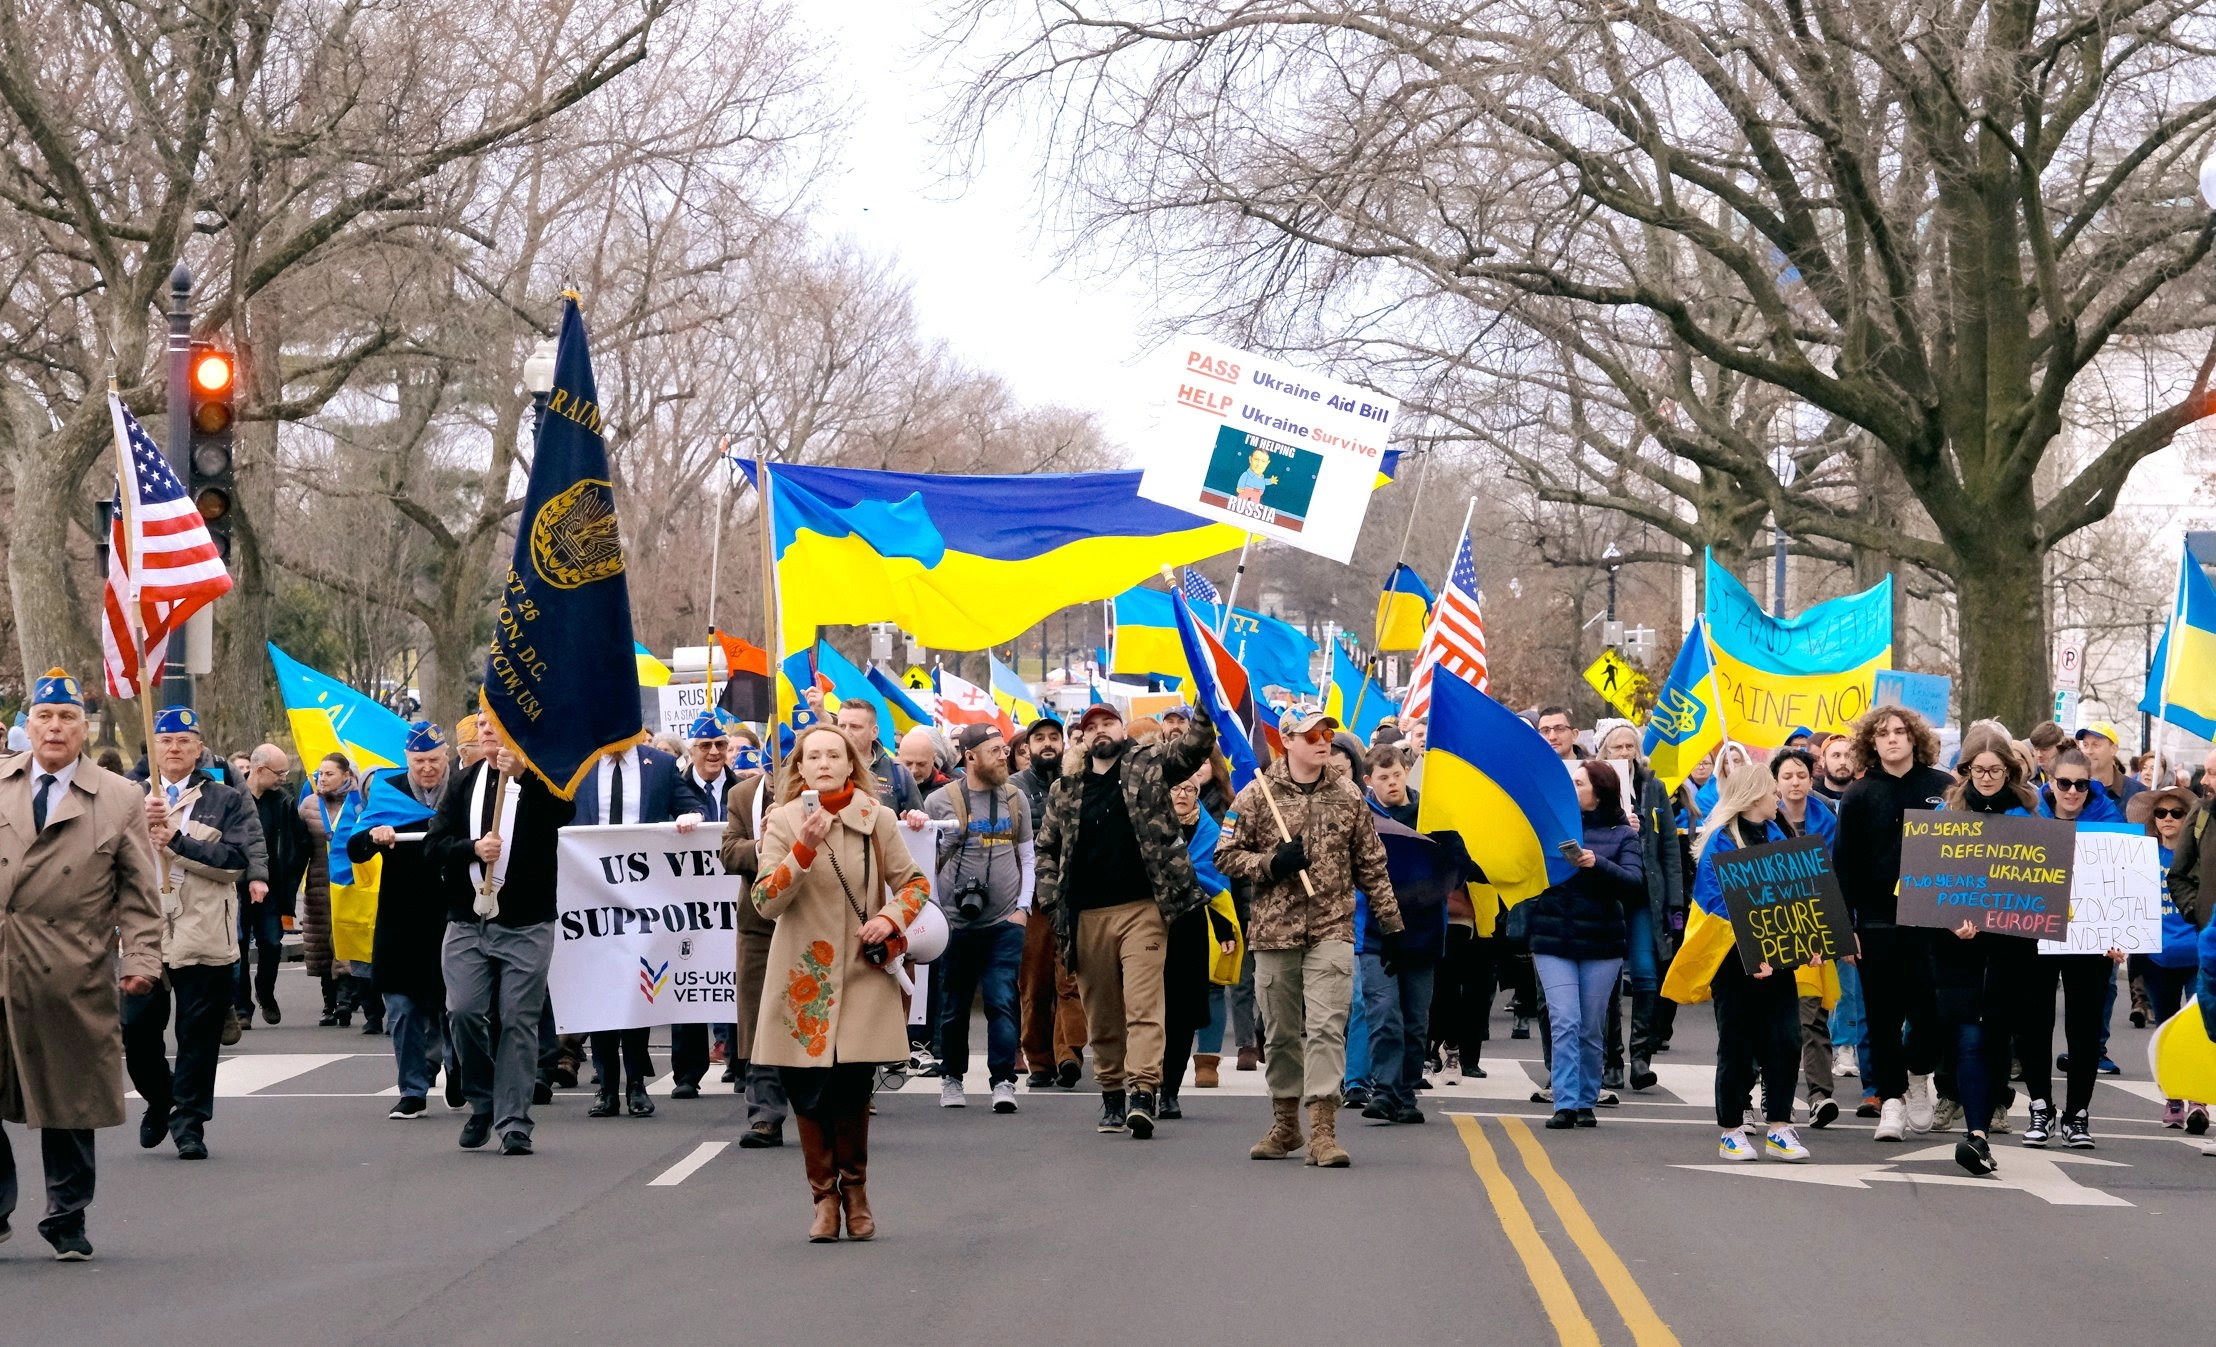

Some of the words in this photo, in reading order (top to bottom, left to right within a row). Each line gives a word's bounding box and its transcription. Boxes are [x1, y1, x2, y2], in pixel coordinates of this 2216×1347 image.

[1187, 351, 1241, 381] PASS
[1252, 370, 1321, 402] Ukraine
[1327, 395, 1356, 413] Aid
[1359, 403, 1389, 423] Bill
[1177, 384, 1233, 411] HELP
[1241, 404, 1309, 437] Ukraine
[1311, 428, 1377, 458] Survive
[1244, 433, 1258, 448] I'M
[1259, 437, 1296, 459] HELPING
[1226, 495, 1277, 524] RUSSIA
[507, 566, 526, 595] ST
[517, 599, 540, 621] 26
[1710, 577, 1792, 656] STAND
[1805, 600, 1880, 656] WITH
[517, 645, 547, 682] D.C.
[516, 689, 543, 722] USA
[665, 710, 671, 721] IS
[674, 710, 681, 720] A
[1903, 821, 1929, 837] TWO
[1931, 821, 1984, 837] YEARS
[1941, 844, 2047, 863] DEFENDING
[599, 851, 650, 885] US
[1903, 874, 1932, 889] TWO
[1935, 873, 1988, 889] YEARS
[1989, 864, 2067, 884] UKRAINE
[1747, 885, 1776, 906] WE
[1777, 878, 1822, 900] WILL
[1937, 891, 2047, 913] POTECTING
[1749, 898, 1828, 939] SECURE
[1986, 910, 2061, 933] EUROPE
[1761, 930, 1836, 964] PEACE
[674, 988, 735, 1002] VETER
